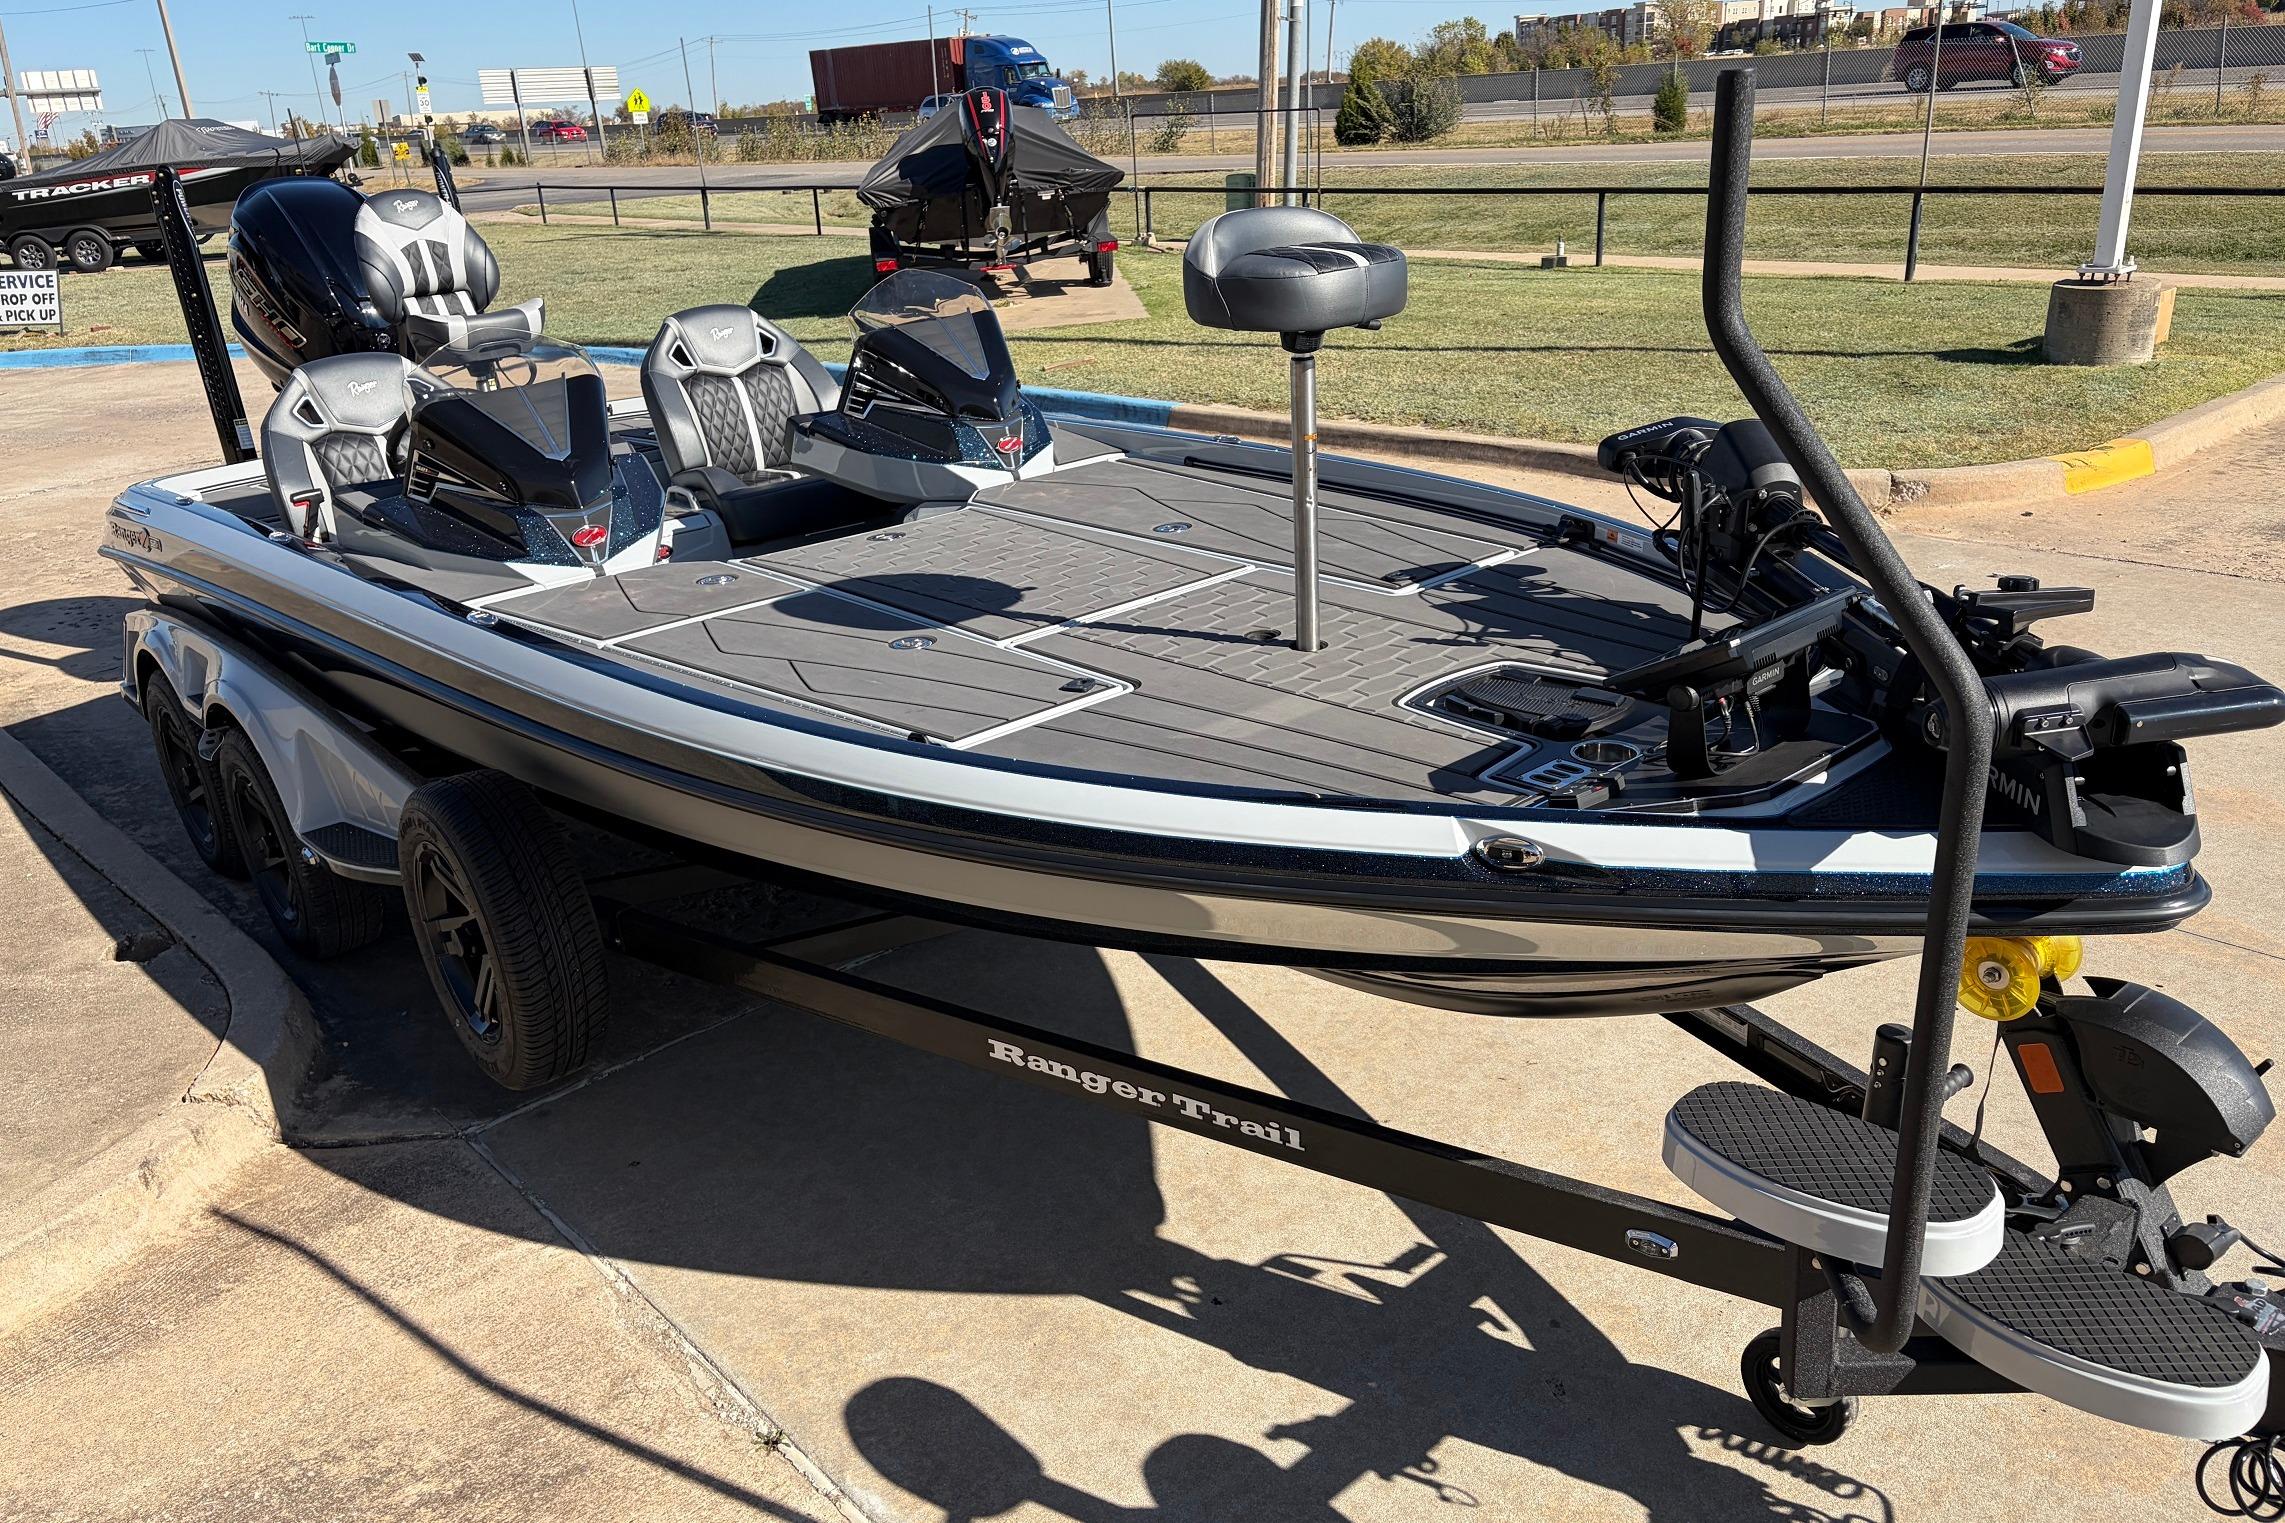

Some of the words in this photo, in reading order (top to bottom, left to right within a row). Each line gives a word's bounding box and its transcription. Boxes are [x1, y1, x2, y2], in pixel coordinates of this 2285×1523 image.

[305, 42, 321, 52] Bart
[346, 43, 356, 53] Dr
[419, 99, 430, 107] 30
[11, 174, 150, 201] TRACKER
[0, 274, 55, 289] ERVICE
[0, 293, 28, 306] ROP
[31, 292, 56, 305] OFF
[5, 309, 37, 322] PICK
[39, 308, 57, 321] UP
[1617, 421, 1675, 441] GARMIN
[1752, 666, 1780, 686] GARMIN
[1988, 765, 2041, 816] RMIN
[986, 1037, 1166, 1108] Ranger
[1172, 1093, 1306, 1152] Trail
